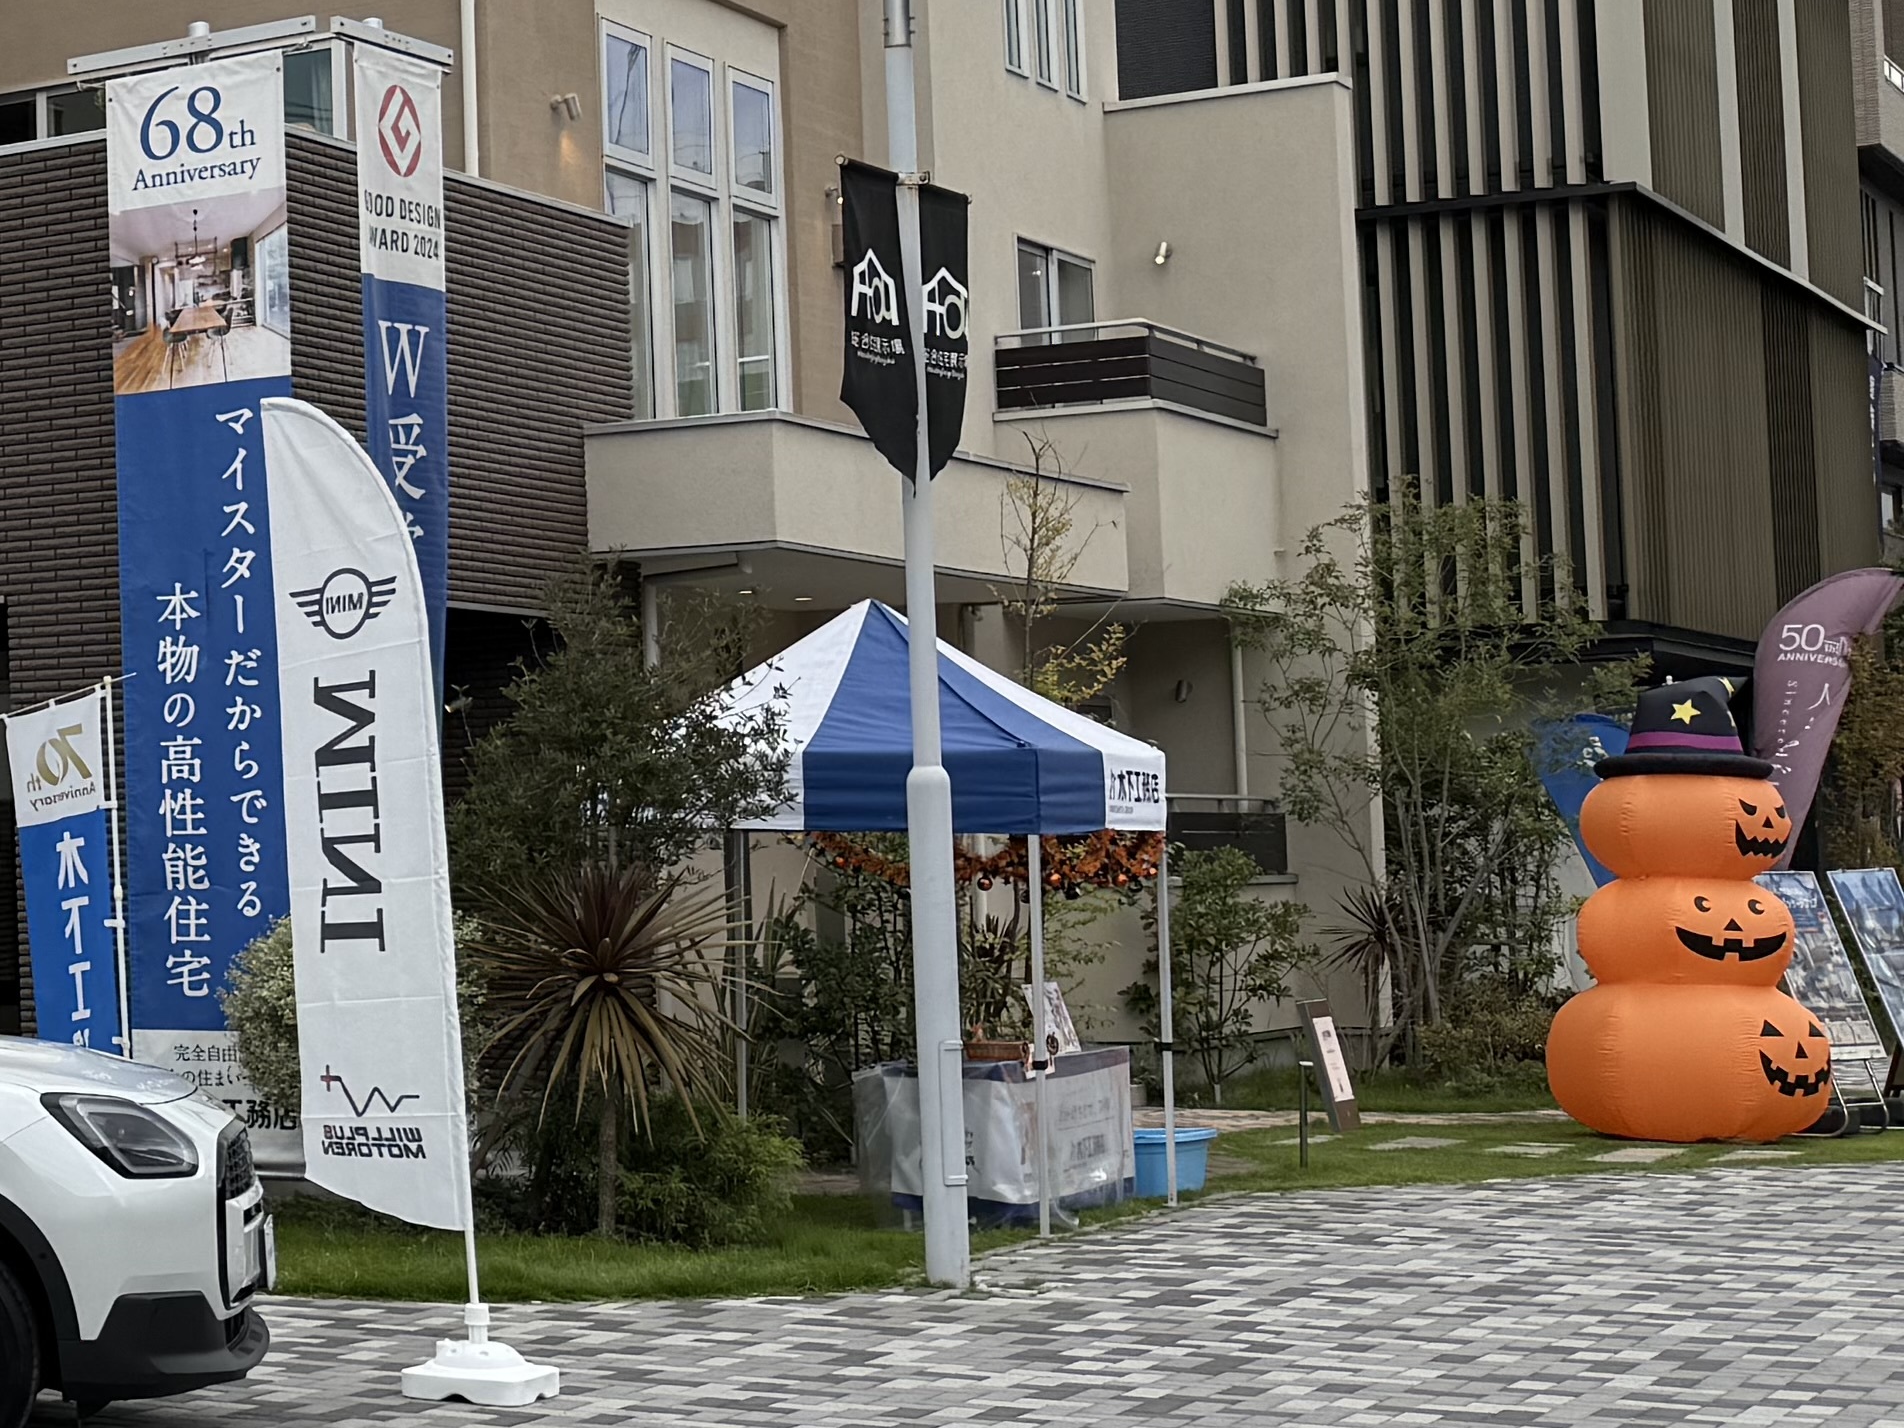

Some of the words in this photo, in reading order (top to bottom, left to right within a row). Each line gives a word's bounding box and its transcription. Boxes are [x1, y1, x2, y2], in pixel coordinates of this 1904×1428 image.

[140, 86, 256, 160] 68th
[132, 157, 261, 191] Anniversary
[400, 198, 441, 230] DESIGN
[369, 224, 410, 253] WARD
[413, 233, 440, 261] 2024
[216, 408, 267, 918] マイスターだからできる
[157, 582, 212, 998] 本物の高性能住宅
[174, 1044, 240, 1063] 完全自由
